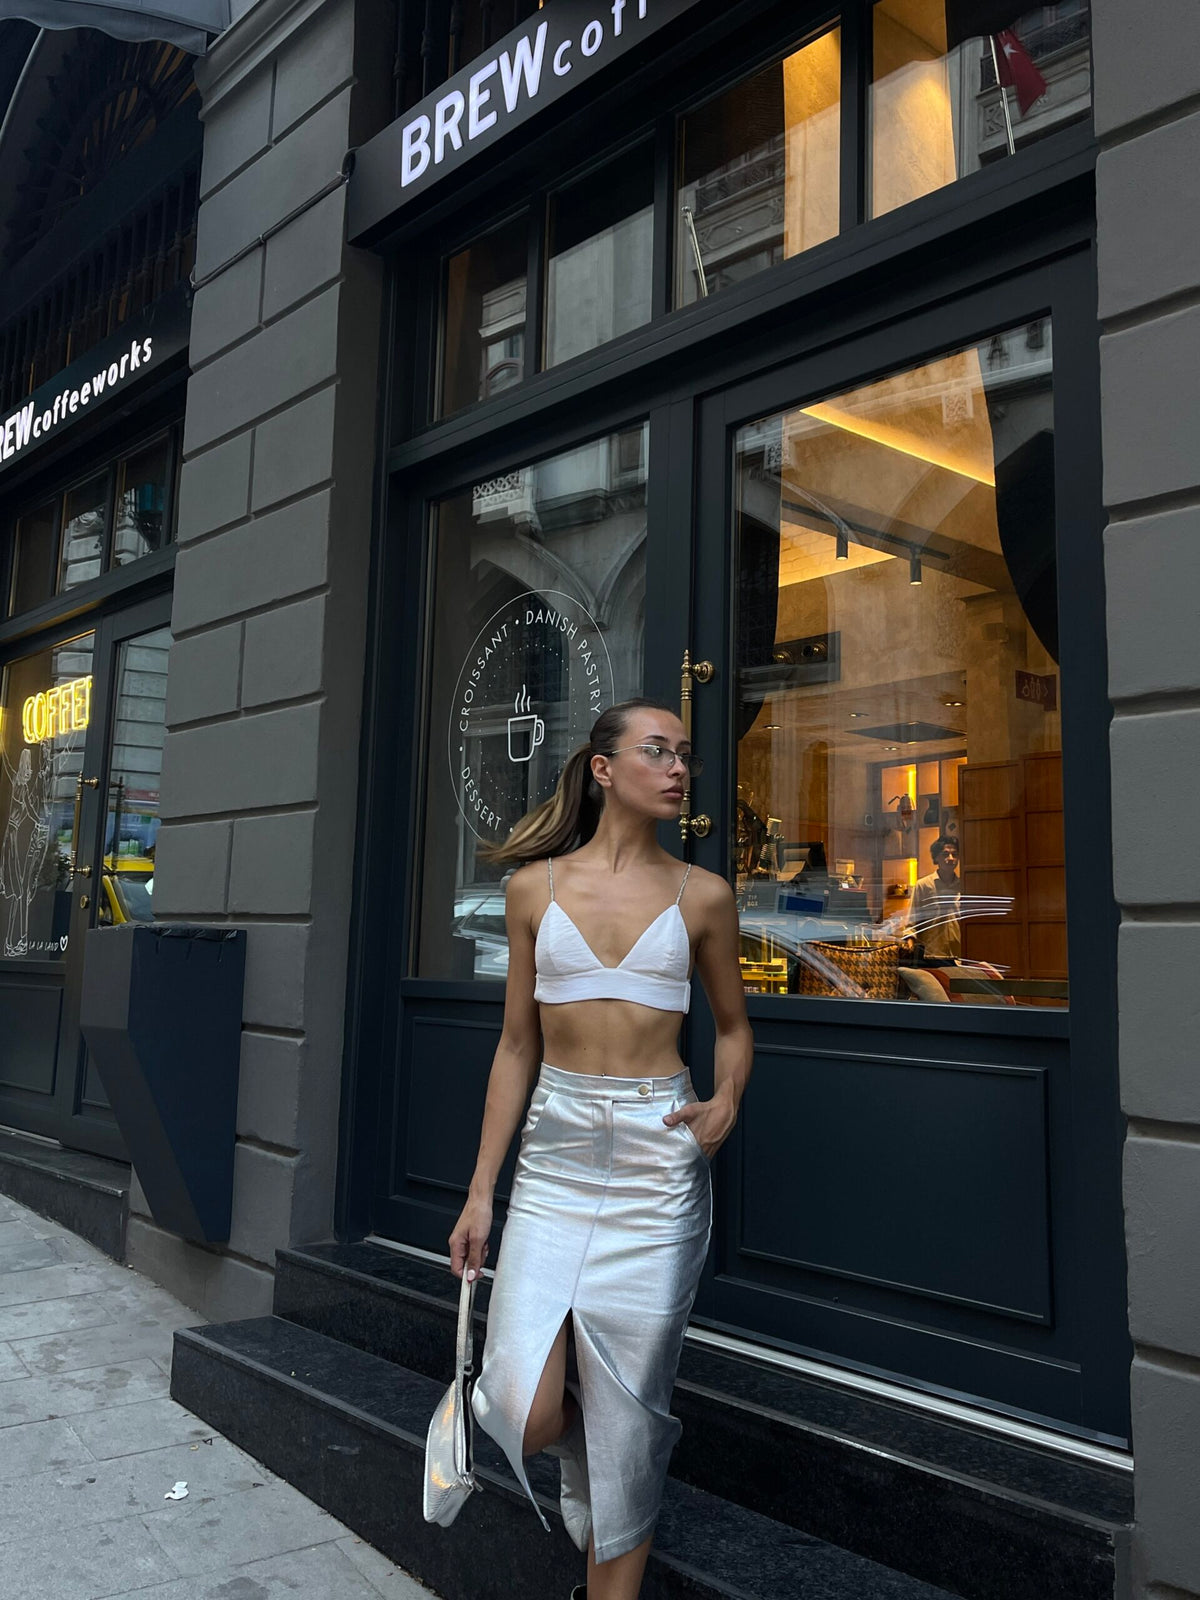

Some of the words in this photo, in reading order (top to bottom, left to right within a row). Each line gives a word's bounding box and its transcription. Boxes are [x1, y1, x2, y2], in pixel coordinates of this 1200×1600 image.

[401, 21, 548, 187] BREW
[33, 337, 153, 438] coffeeworks
[459, 623, 509, 732] CROISSANT
[526, 610, 578, 640] DANISH
[577, 638, 601, 714] PASTRY
[461, 766, 502, 831] DESSERT
